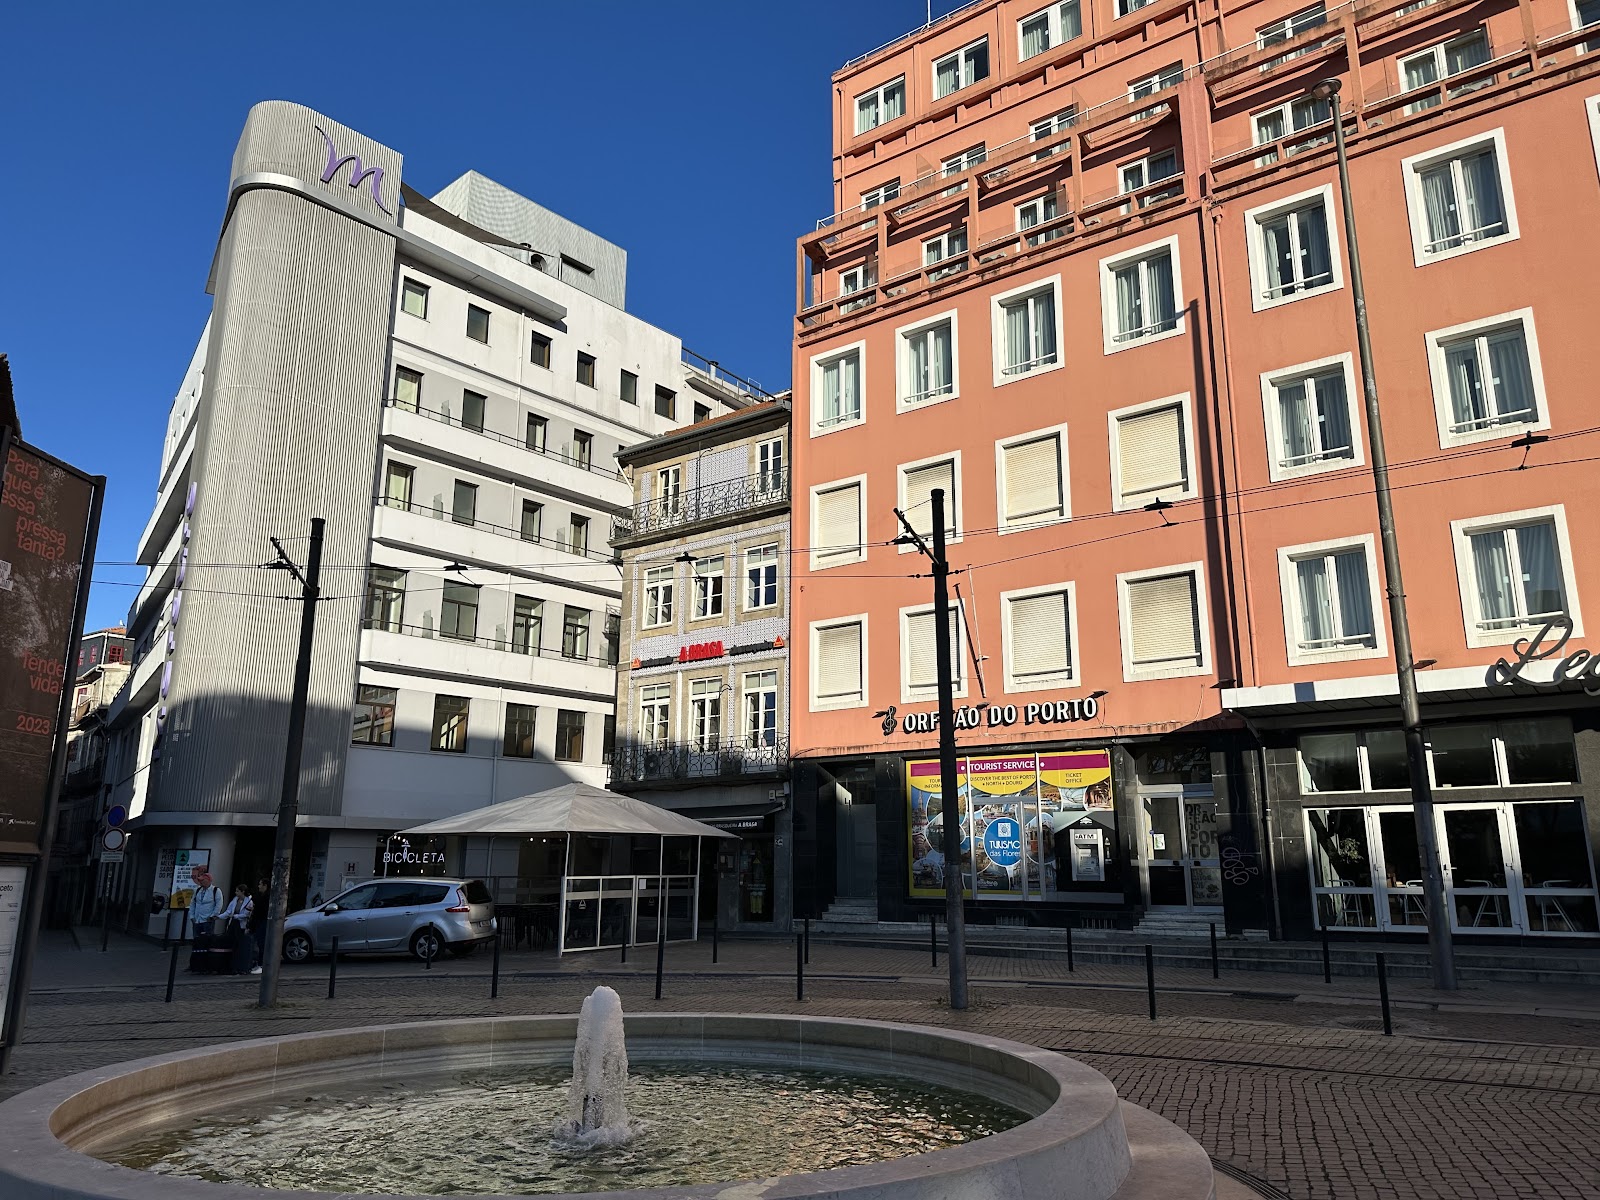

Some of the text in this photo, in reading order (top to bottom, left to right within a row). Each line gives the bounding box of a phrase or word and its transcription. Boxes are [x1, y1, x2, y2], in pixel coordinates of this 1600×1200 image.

[7, 448, 40, 480] Para
[4, 471, 45, 501] que é
[1, 488, 36, 516] essa
[16, 515, 67, 547] pressa
[17, 532, 66, 561] tanta?
[16, 714, 52, 735] 2023
[904, 697, 1097, 733] ORFÃO DO PORTO
[970, 760, 1035, 771] TOURIST SERVICE
[383, 851, 445, 864] BICICLETA
[989, 840, 1021, 849] TURISMO
